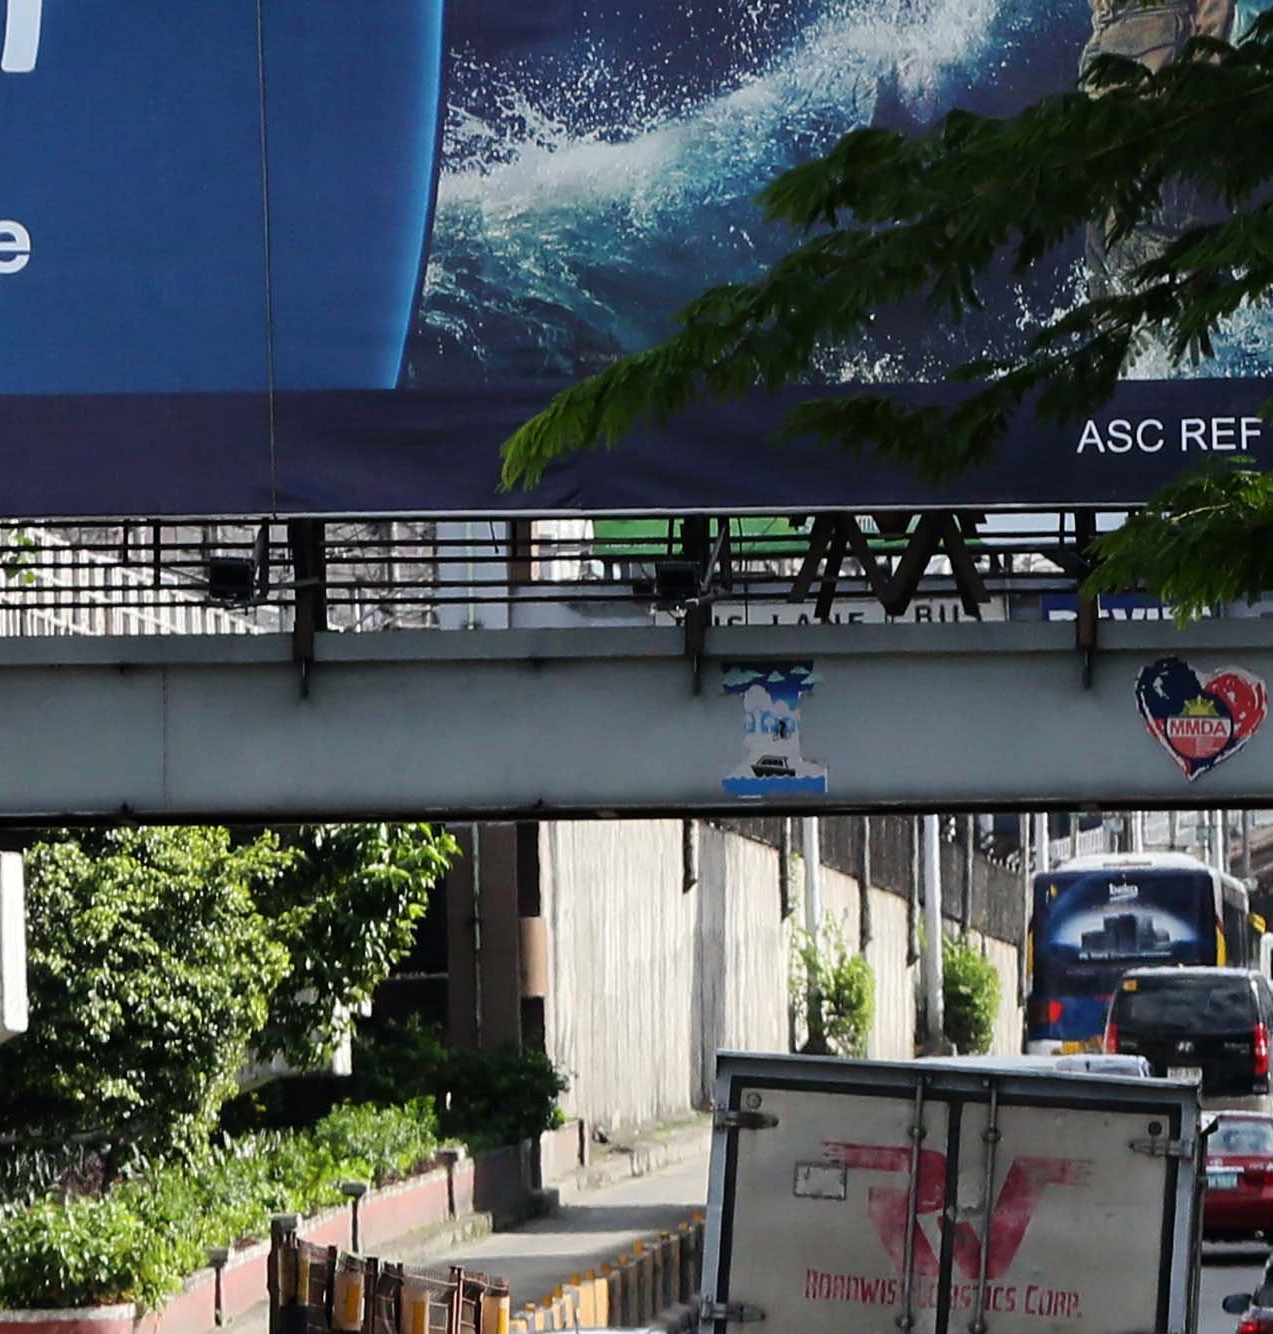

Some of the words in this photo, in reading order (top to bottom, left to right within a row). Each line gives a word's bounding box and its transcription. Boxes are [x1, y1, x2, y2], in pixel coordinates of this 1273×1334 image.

[1076, 419, 1165, 454] ASC
[1180, 417, 1262, 452] REF
[1169, 719, 1227, 737] MMDA
